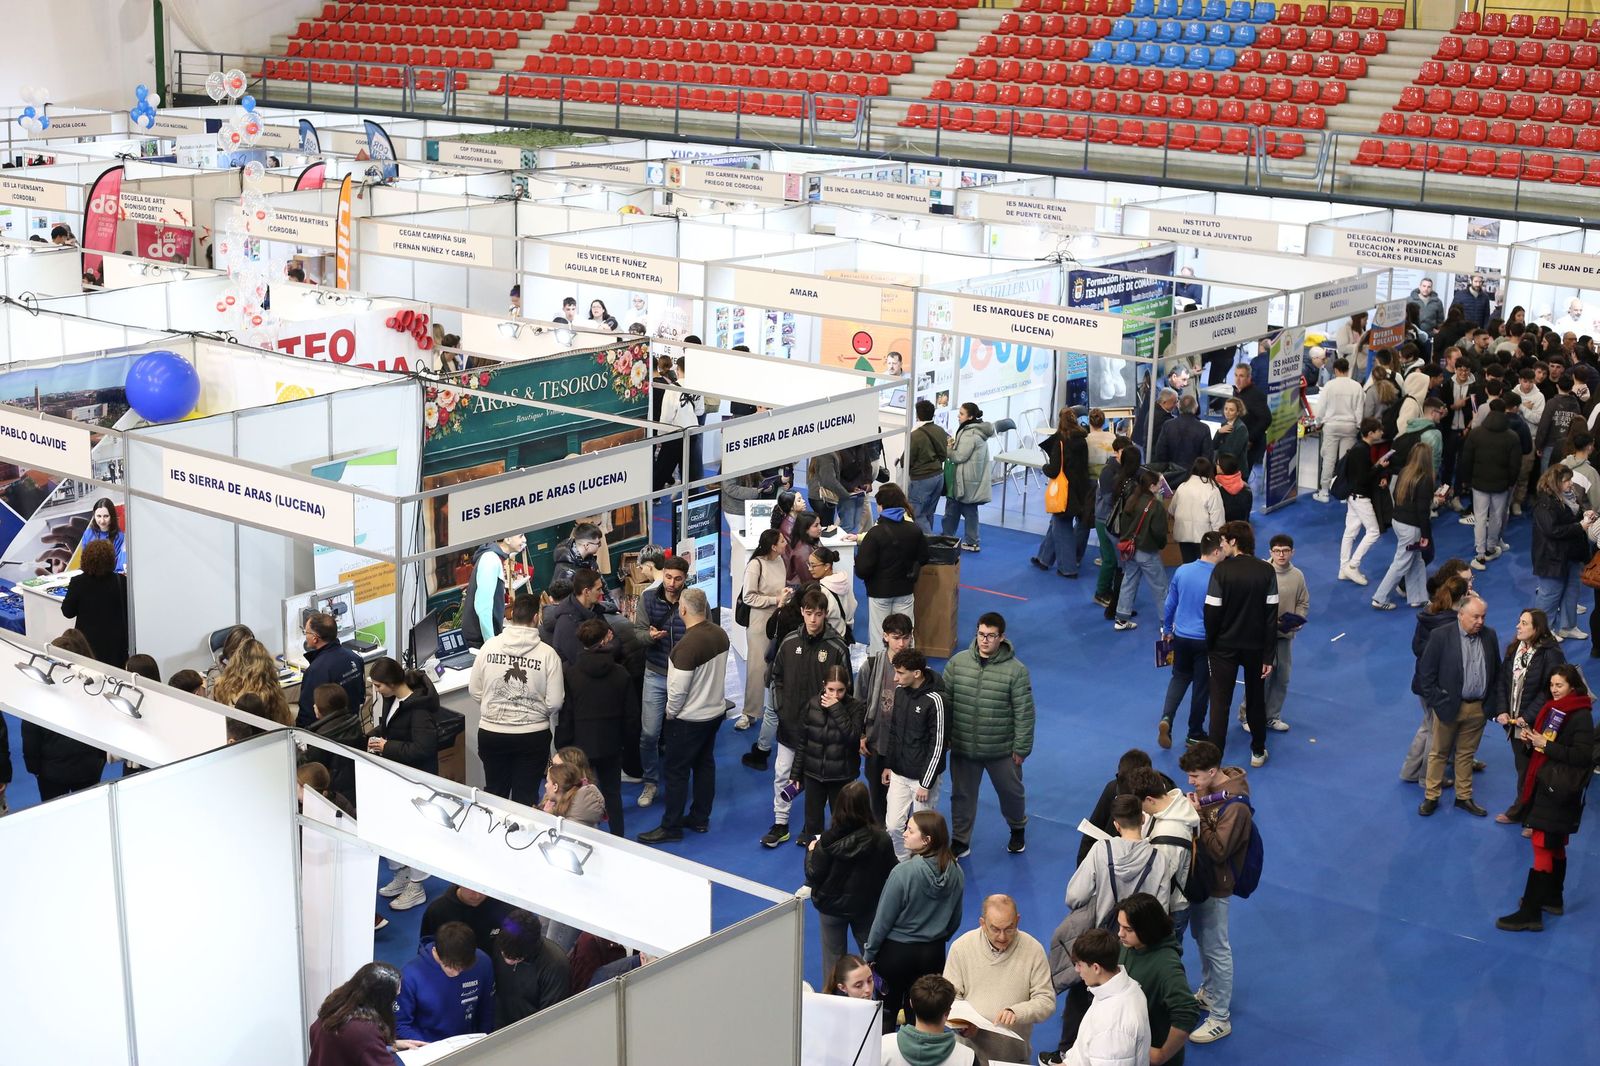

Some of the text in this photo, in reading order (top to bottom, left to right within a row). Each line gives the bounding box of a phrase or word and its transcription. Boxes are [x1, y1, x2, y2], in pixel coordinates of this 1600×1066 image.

[18, 184, 44, 192] FUENSANTA
[850, 188, 884, 198] GARCILASO
[896, 194, 926, 202] MONTILLA
[124, 203, 147, 211] DIONISIO
[1018, 202, 1045, 210] MANUEL
[1046, 204, 1066, 212] REINA
[276, 214, 298, 222] SANTOS
[1183, 219, 1220, 228] INSTITUTO
[399, 229, 421, 238] CEGAM
[453, 236, 467, 244] SUR
[1158, 226, 1190, 235] ANDALUZ
[1214, 232, 1252, 242] JUVENTUD
[1398, 239, 1445, 250] PROVINCIAL
[452, 250, 476, 260] CABRA)
[577, 252, 588, 260] IES
[590, 253, 620, 264] VICENTE
[1357, 250, 1402, 260] ESCOLARES
[1403, 247, 1456, 258] RESIDENCIAS
[565, 263, 662, 284] (AGUILAR DE LA FRONTERA)
[1126, 282, 1134, 290] DE
[790, 288, 818, 298] AMARA
[973, 304, 988, 312] IES
[1038, 312, 1050, 321] DE
[1052, 314, 1098, 328] COMARES
[1190, 320, 1198, 328] IES
[1225, 312, 1232, 320] DE
[1233, 306, 1258, 318] COMARES
[1010, 323, 1054, 338] (LUCENA)
[1212, 326, 1236, 340] (LUCENA)
[540, 372, 609, 400] TESOROS
[516, 412, 544, 422] Boutique
[0, 425, 67, 451] PABLO OLAVIDE
[726, 413, 856, 453] IES SIERRA DE ARAS (LUCENA)
[170, 468, 326, 519] IES SIERRA DE ARAS (LUCENA)
[461, 470, 628, 522] IES SIERRA DE ARAS (LUCENA)
[687, 520, 710, 530] ORMATIVOS
[486, 653, 542, 671] ONE PIECE
